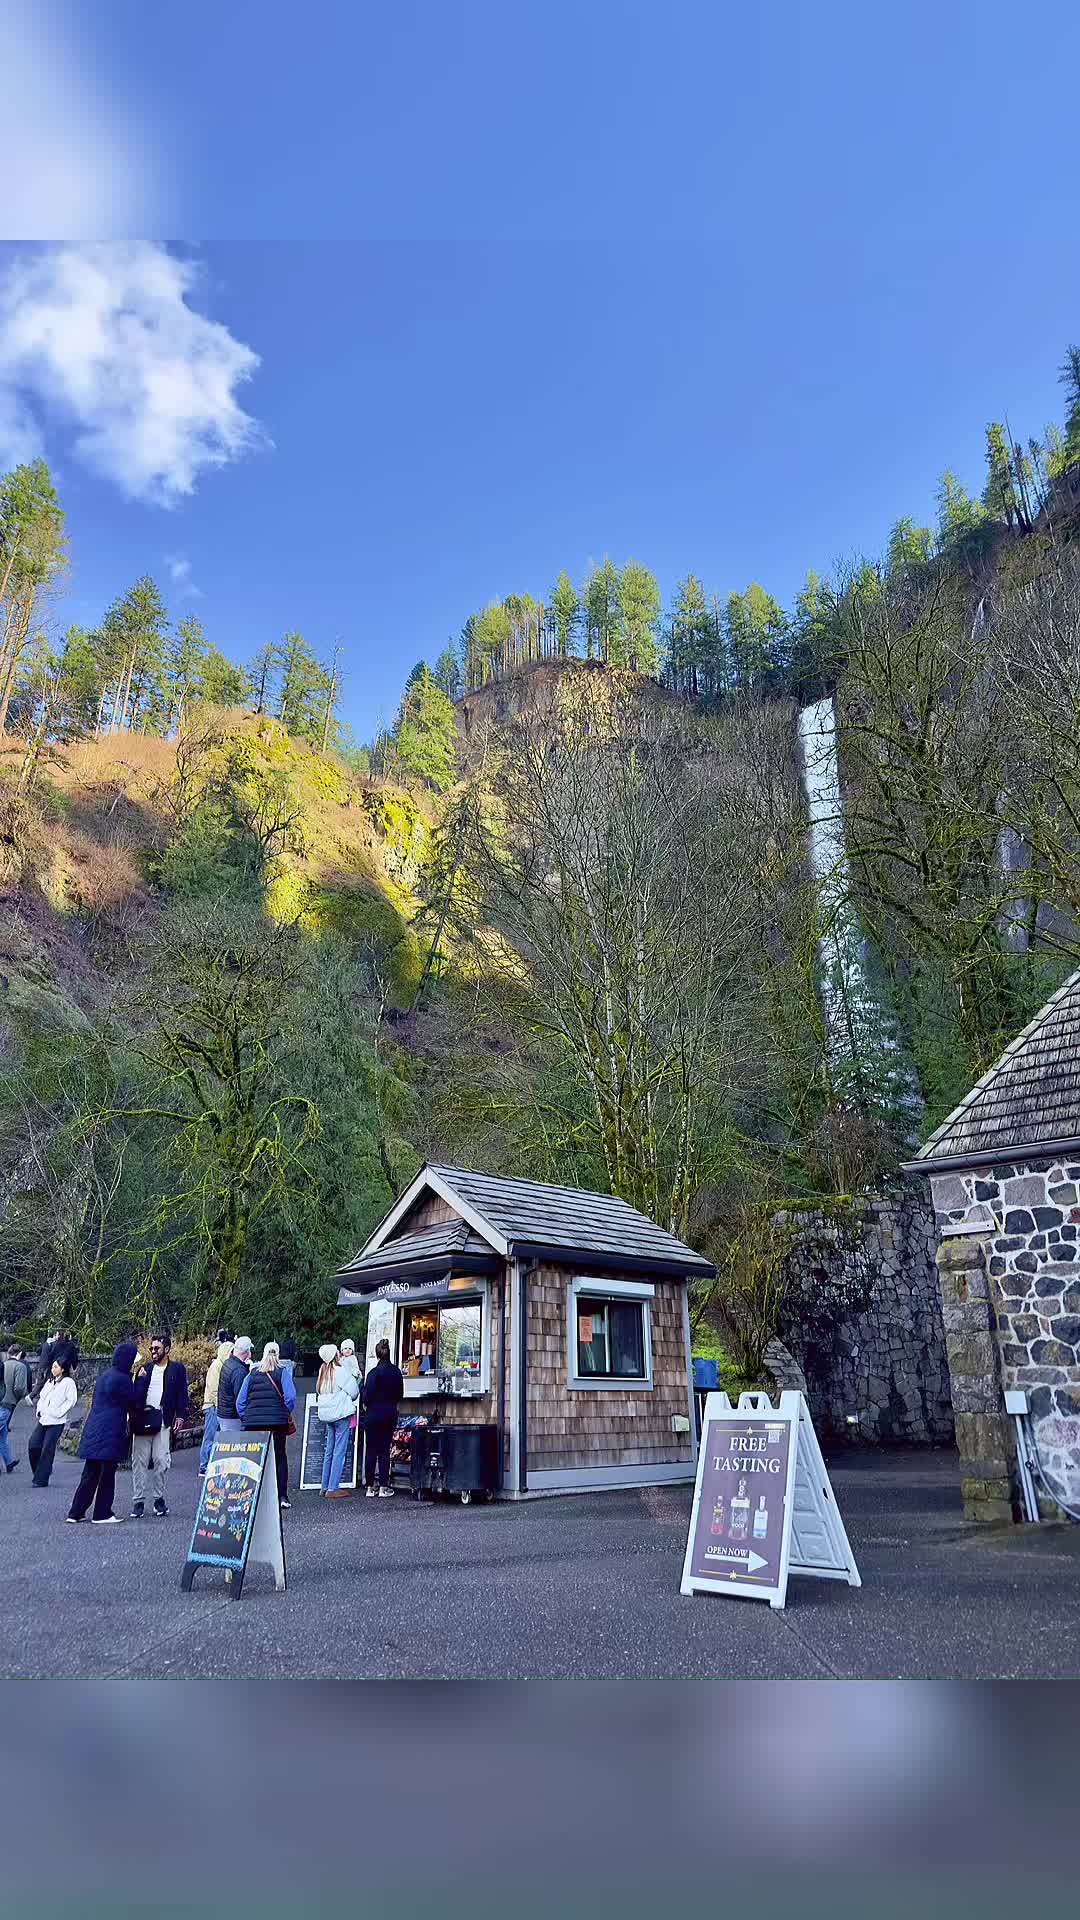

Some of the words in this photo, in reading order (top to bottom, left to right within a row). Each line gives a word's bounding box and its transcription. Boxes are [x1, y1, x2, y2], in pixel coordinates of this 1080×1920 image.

[377, 1282, 410, 1297] ESPRESSO
[729, 1437, 767, 1452] FREE
[712, 1456, 781, 1473] TASTING
[707, 1545, 728, 1555] OPEN
[728, 1547, 748, 1557] NOW
